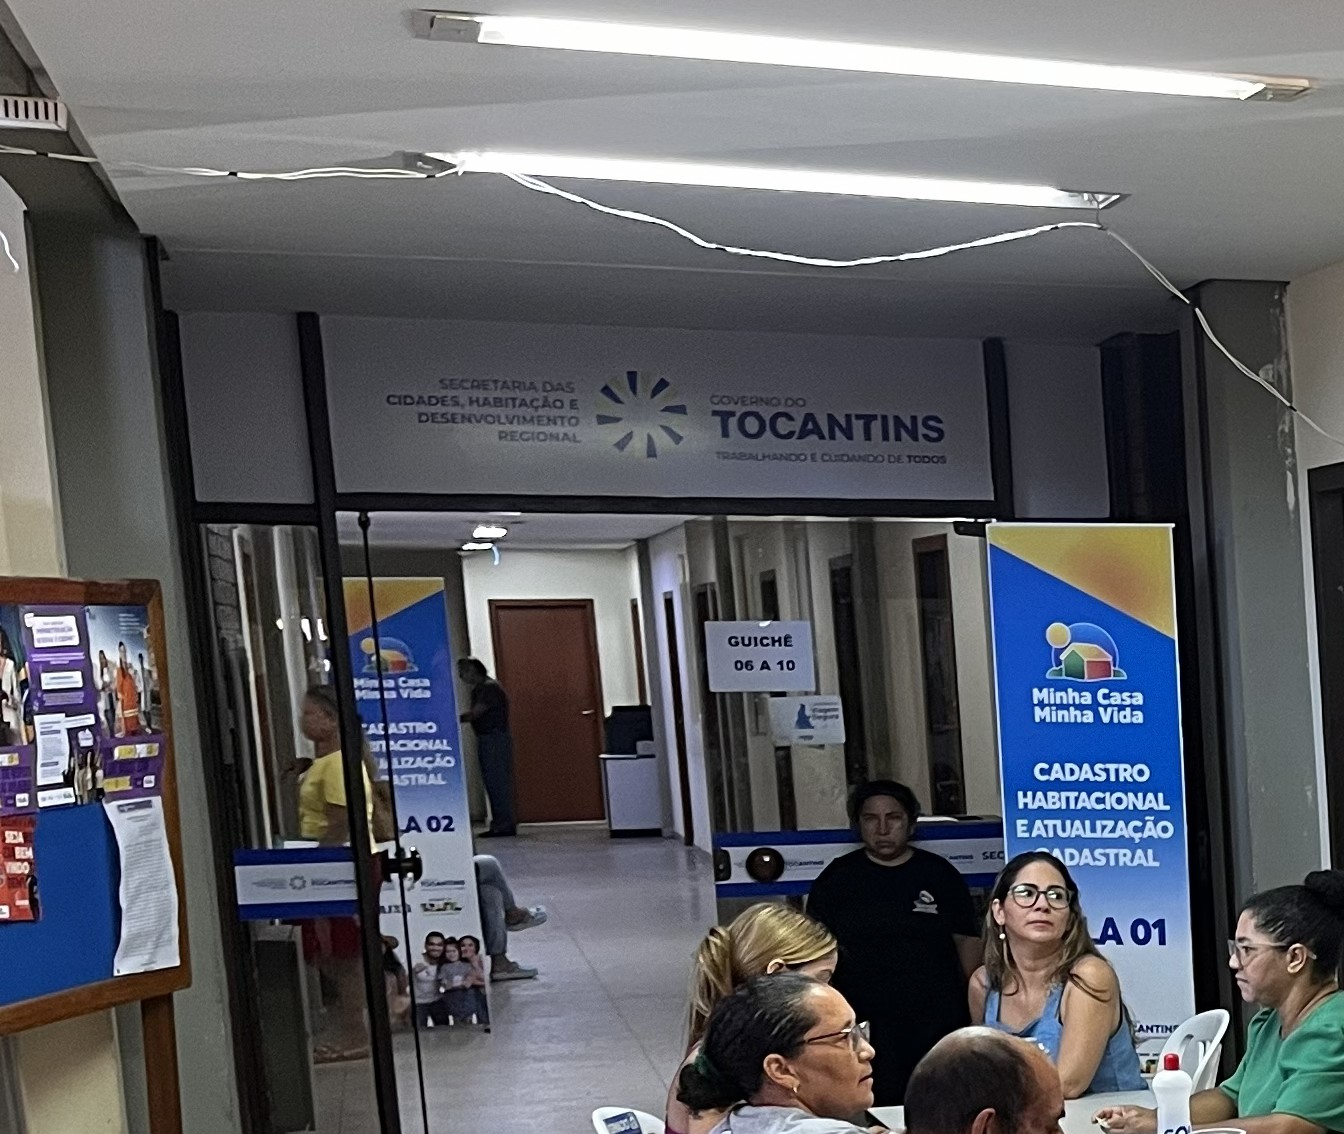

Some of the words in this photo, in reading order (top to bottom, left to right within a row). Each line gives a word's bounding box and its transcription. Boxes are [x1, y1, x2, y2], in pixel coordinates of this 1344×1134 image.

[439, 378, 538, 392] SECRETARIA
[541, 380, 575, 394] DAS
[386, 394, 464, 408] CIDADES,
[468, 396, 564, 412] HABITAÇÃO
[570, 398, 580, 410] E
[710, 394, 780, 408] GOVERNO
[784, 396, 806, 408] DO
[417, 412, 580, 427] DESENVOLVIMENTO
[711, 410, 946, 444] TOCANTINS
[498, 430, 581, 444] REGIONAL
[906, 454, 946, 465] TODOS
[727, 634, 794, 648] GUICHÊ
[734, 660, 754, 672] 06
[760, 660, 771, 671] A
[776, 660, 796, 672] 10
[1032, 688, 1092, 705] Minha
[1096, 688, 1144, 706] Casa
[1034, 706, 1094, 723] Minha
[1098, 706, 1144, 724] Vida
[1033, 763, 1150, 782] CADASTRO
[1017, 791, 1170, 810] HABITACIONAL
[426, 815, 455, 833] 02
[1016, 819, 1030, 838] E
[1031, 816, 1174, 843] ATUALIZAÇÃO
[1130, 918, 1166, 946] 01
